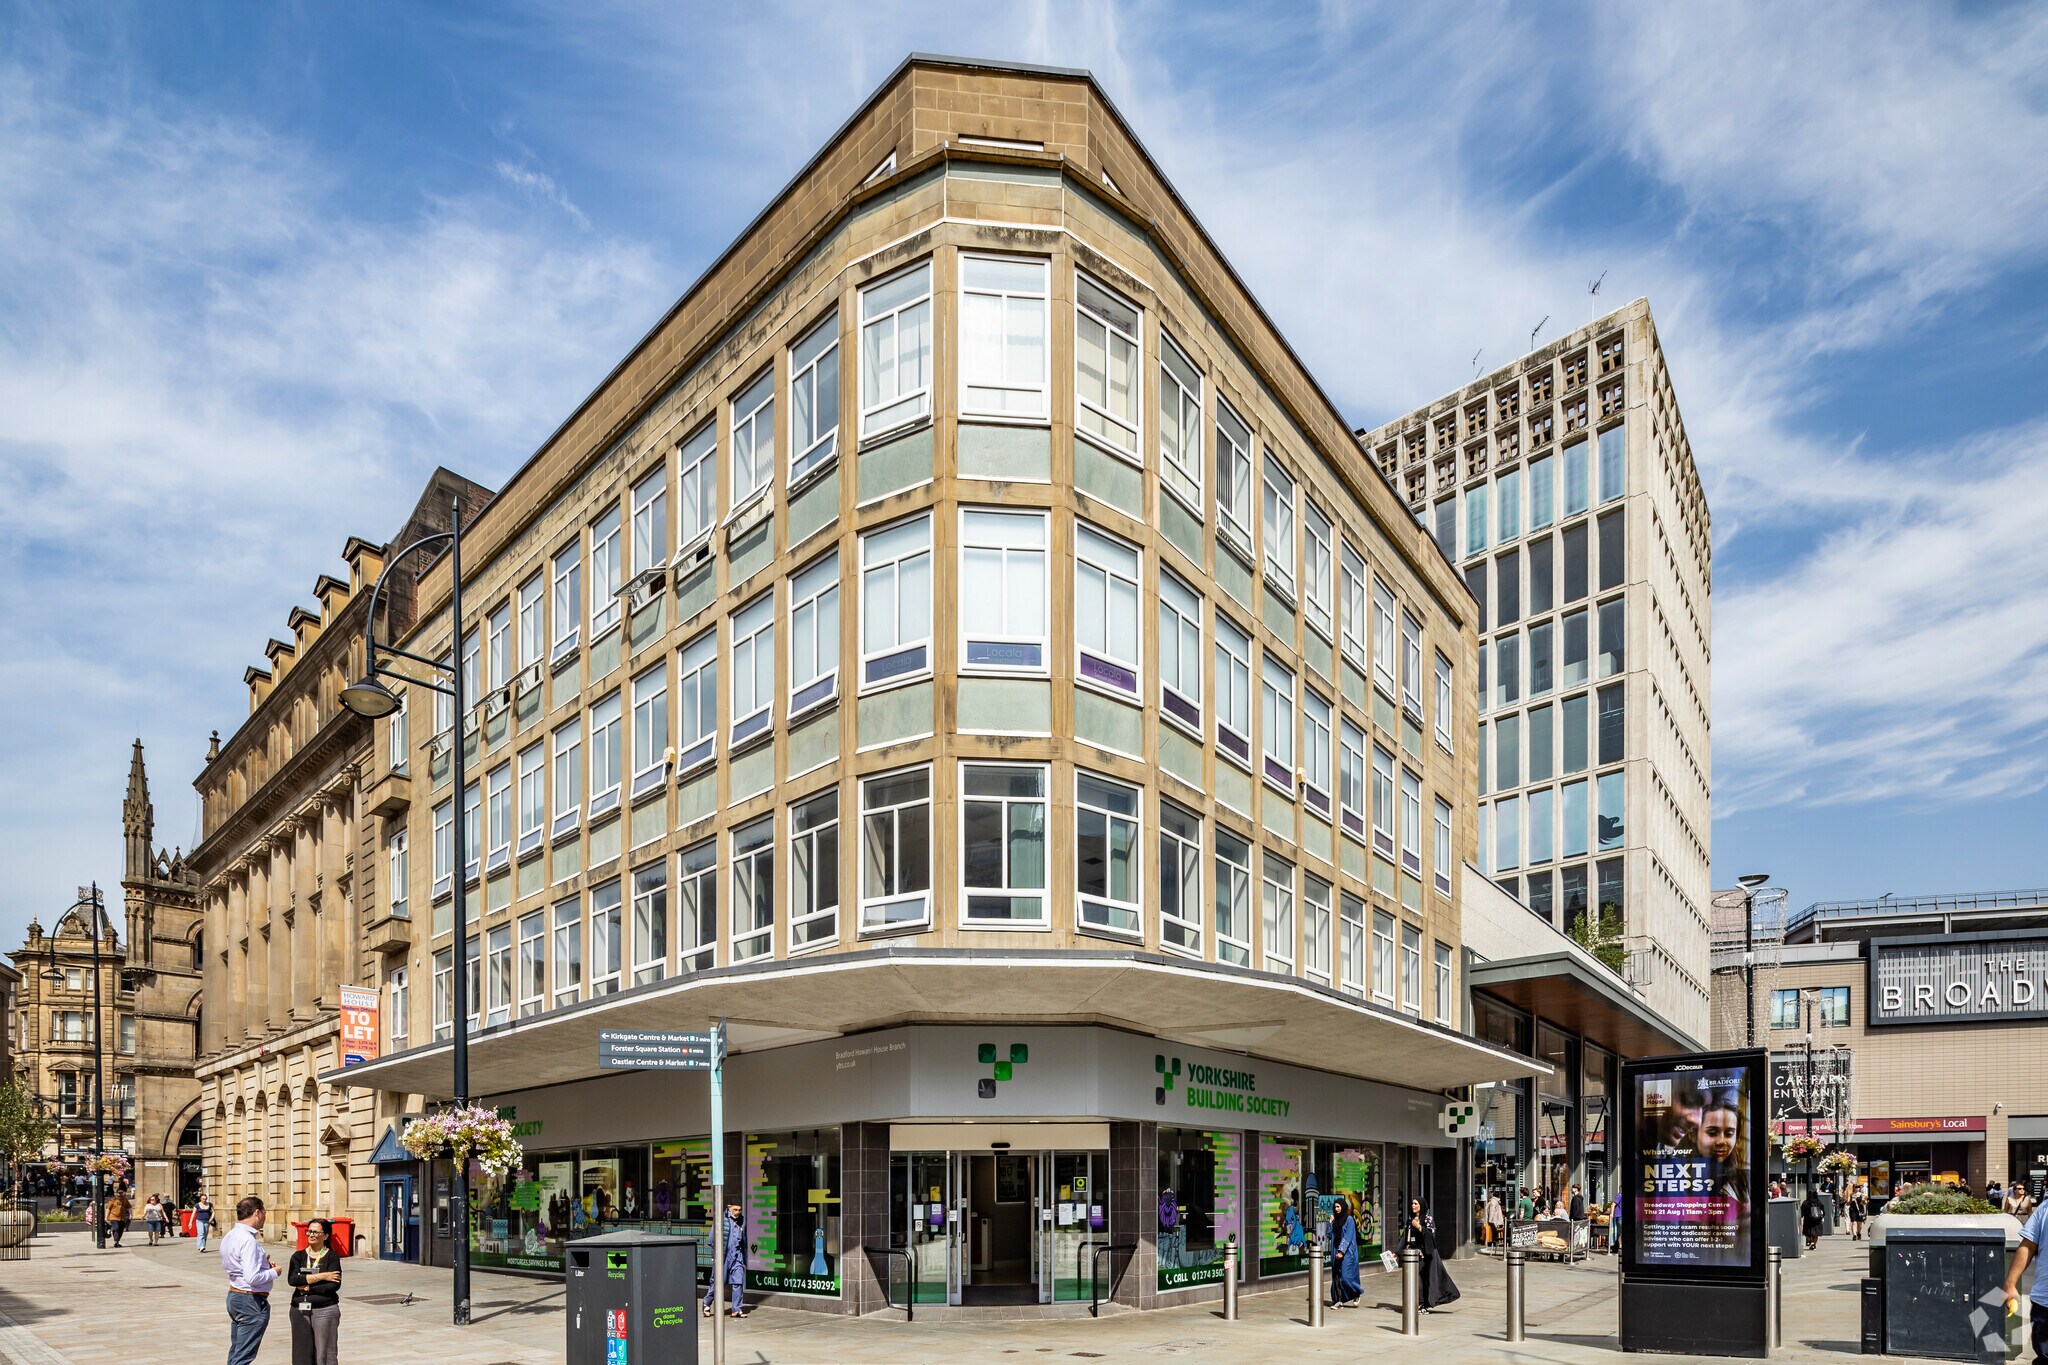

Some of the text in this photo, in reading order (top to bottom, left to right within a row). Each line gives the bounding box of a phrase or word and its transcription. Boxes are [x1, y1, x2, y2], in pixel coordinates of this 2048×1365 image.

[1985, 960, 2025, 973] THE
[344, 993, 375, 1001] HOWARD
[1883, 978, 2048, 1010] BROAD
[344, 999, 374, 1007] HOUSE
[347, 1011, 370, 1025] TO
[344, 1025, 374, 1040] LET
[610, 1033, 637, 1041] Kirkgate
[835, 1050, 854, 1059] Bradford
[889, 1042, 906, 1051] Branch
[1187, 1063, 1256, 1091] YORKSHIRE
[1775, 1075, 1803, 1086] CAR
[1187, 1087, 1290, 1117] BUILDING SOCIETY
[1890, 1119, 1967, 1130] Sainsbury's Local
[1644, 1163, 1706, 1179] NEXT
[1644, 1179, 1715, 1192] STEPS?
[608, 1271, 625, 1280] Recycling
[1173, 1272, 1188, 1283] CALL
[1192, 1269, 1211, 1281] 01274
[763, 1276, 836, 1291] CALL 01274 350292
[654, 1306, 684, 1314] BRADFORD
[663, 1318, 683, 1326] recycle
